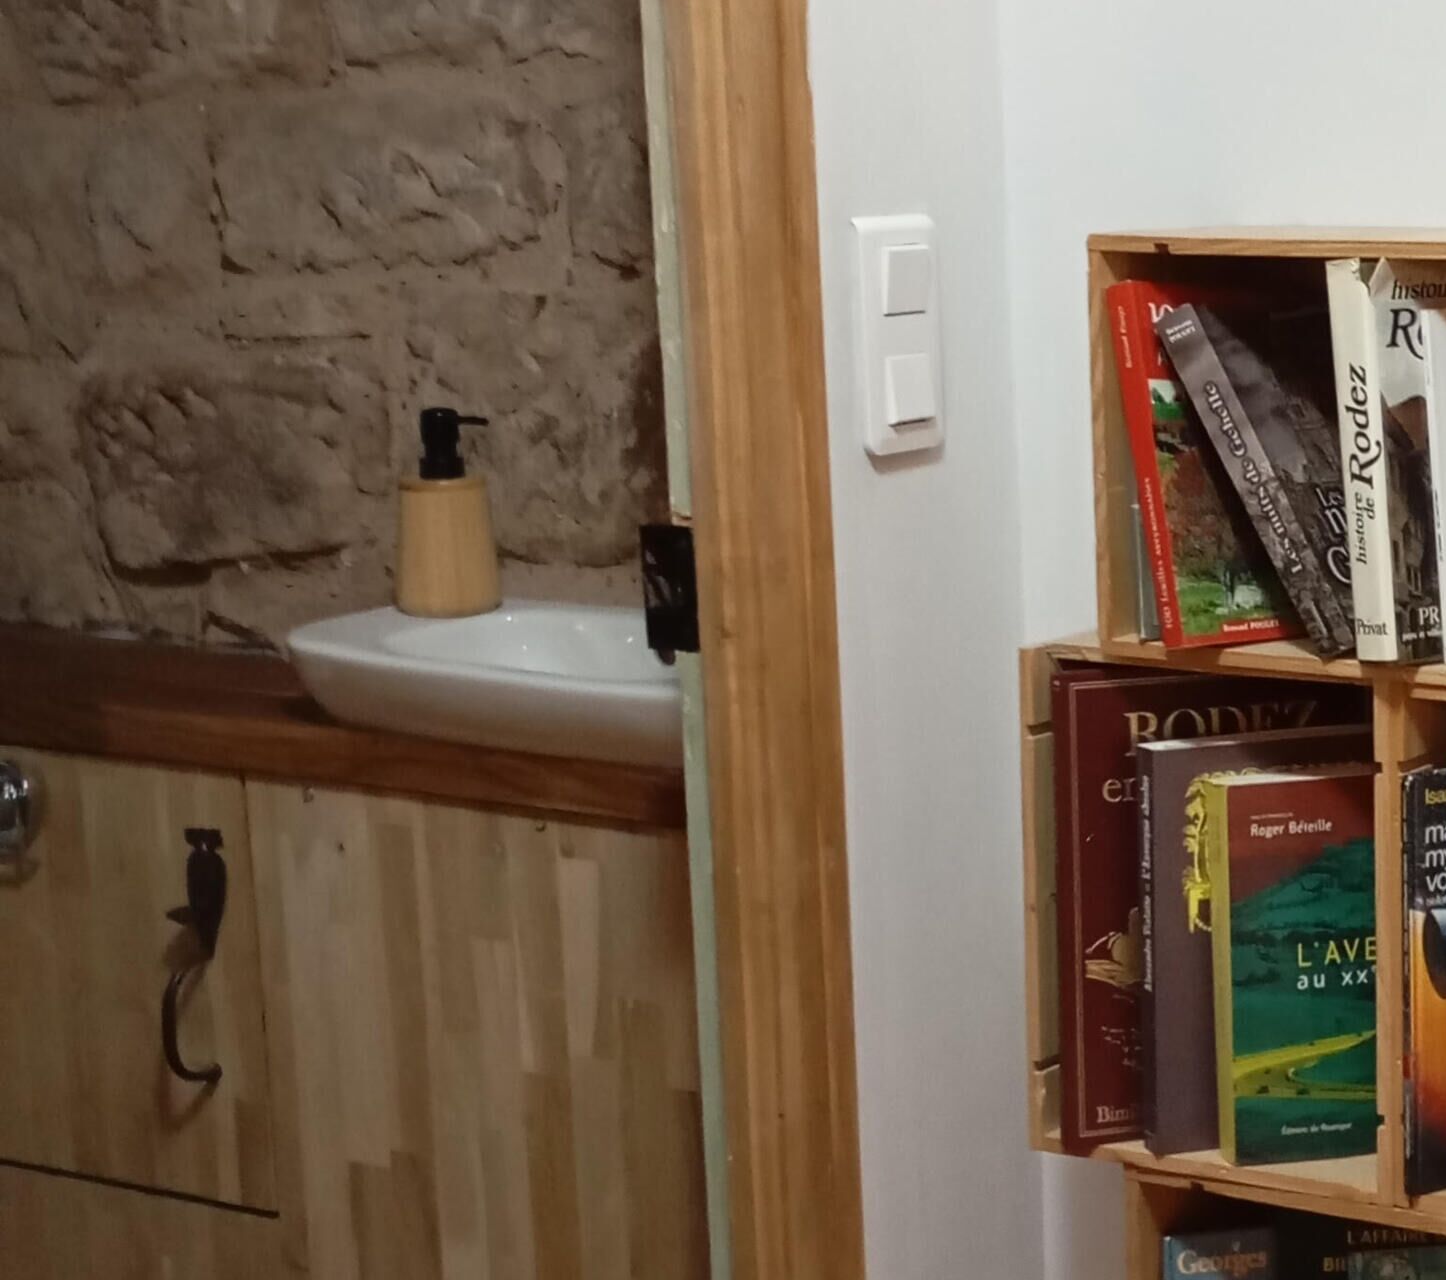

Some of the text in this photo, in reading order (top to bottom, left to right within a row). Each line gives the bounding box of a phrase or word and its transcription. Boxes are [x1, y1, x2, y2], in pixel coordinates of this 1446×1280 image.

[1243, 457, 1261, 484] de
[1345, 364, 1382, 566] histoire de Rodez
[1356, 619, 1389, 637] Privat
[1250, 822, 1285, 839] Roger
[1296, 972, 1326, 990] au
[1175, 1248, 1269, 1277] Georges
